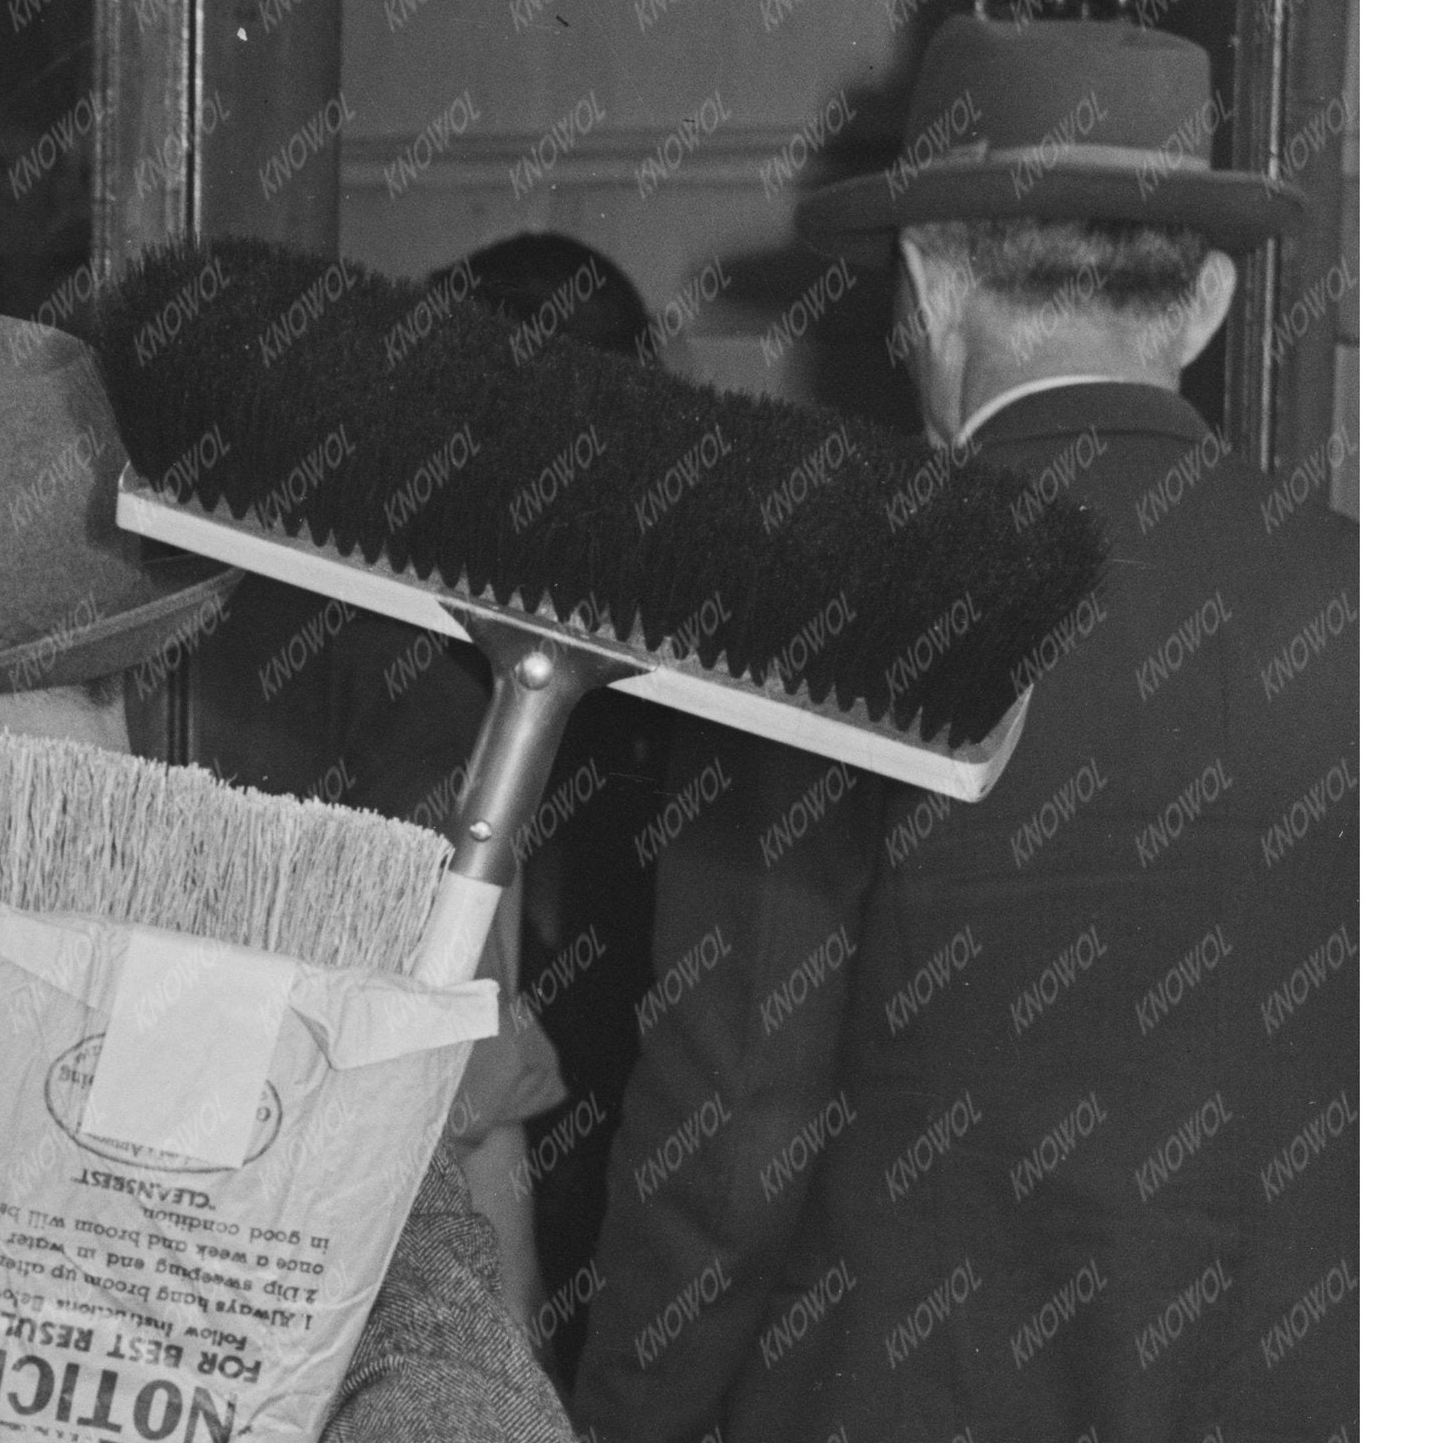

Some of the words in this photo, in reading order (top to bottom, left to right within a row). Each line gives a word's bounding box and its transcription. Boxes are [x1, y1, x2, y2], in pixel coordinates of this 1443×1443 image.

[27, 1209, 65, 1232] will
[74, 1218, 140, 1245] broom
[6, 1230, 66, 1255] water
[147, 1233, 187, 1255] and
[249, 1223, 300, 1248] good
[310, 1236, 330, 1254] in
[76, 1245, 96, 1260] in
[106, 1251, 145, 1272] end
[195, 1243, 247, 1265] week
[256, 1255, 270, 1269] a
[51, 1262, 78, 1286] up
[155, 1259, 253, 1292] sweeping
[276, 1256, 324, 1279] once
[83, 1273, 150, 1302] broom
[156, 1286, 209, 1314] hang
[215, 1297, 296, 1328] Always
[184, 1325, 247, 1351] Follow
[107, 1334, 183, 1368] BEST
[196, 1350, 261, 1384] FOR
